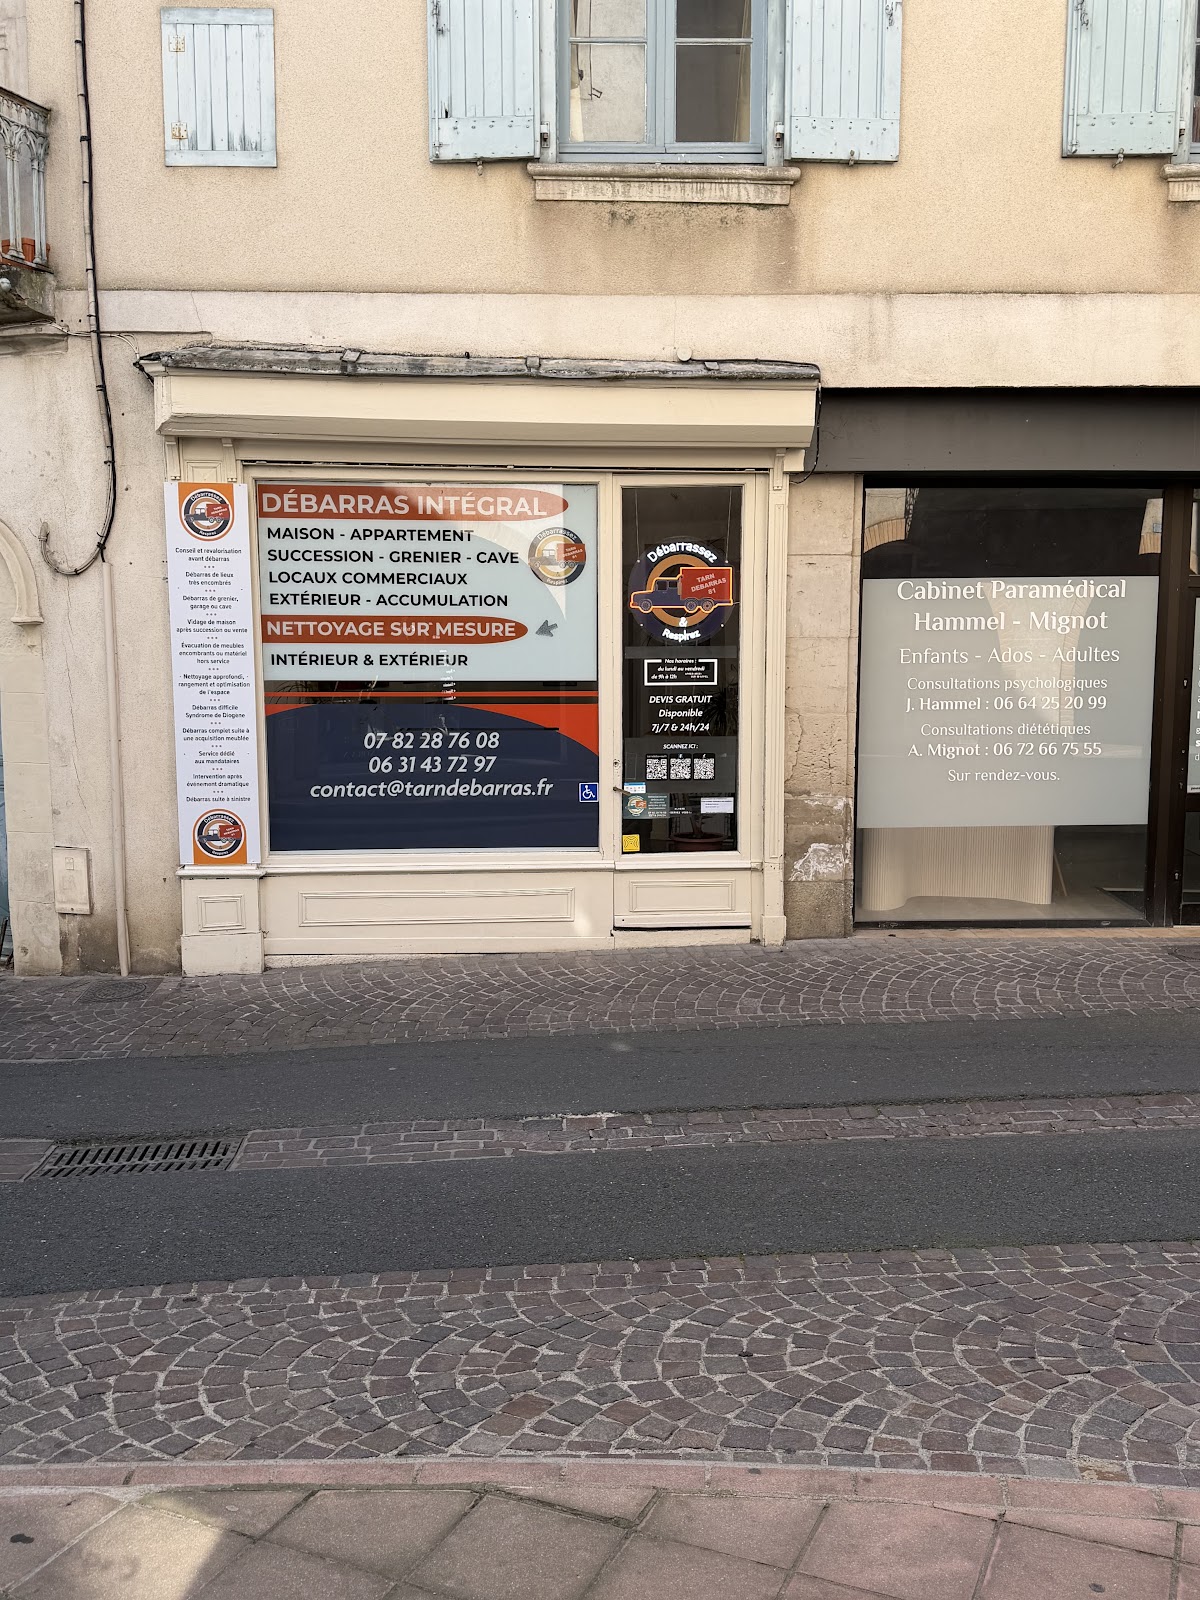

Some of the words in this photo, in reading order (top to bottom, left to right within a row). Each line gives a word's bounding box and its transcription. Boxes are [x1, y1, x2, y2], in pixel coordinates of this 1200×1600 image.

[262, 489, 410, 515] DÉBARRAS
[418, 492, 547, 516] INTÉGRAL
[267, 527, 335, 540] MAISON
[350, 528, 474, 542] APPARTEMENT
[267, 549, 373, 562] SUCCESSION
[389, 551, 461, 563] GRENIER
[476, 551, 519, 564] CAVE
[647, 542, 717, 563] Débarrassez
[268, 571, 337, 584] LOCAUX
[342, 572, 468, 585] COMMERCIAUX
[691, 578, 726, 592] DEBARRAS
[696, 573, 715, 582] TARN
[897, 581, 984, 600] Cabinet
[991, 579, 1126, 599] Paramédical
[269, 591, 361, 606] EXTÉRIEUR
[376, 594, 508, 607] ACCUMULATION
[267, 621, 384, 636] NETTOYAGE
[391, 622, 429, 637] SUR
[436, 622, 516, 637] MESURE
[679, 617, 687, 627] &
[914, 612, 1005, 631] Hammel
[1029, 611, 1108, 634] Mignot
[662, 628, 701, 642] Respirez
[271, 651, 358, 666] INTÉRIEUR
[363, 654, 374, 666] &
[379, 652, 468, 666] EXTÉRIEUR
[900, 648, 969, 664] Enfants
[988, 647, 1033, 663] Ados
[1052, 647, 1120, 662] Adultes
[907, 677, 1000, 690] Consultations
[1004, 677, 1108, 691] psychologiques
[675, 695, 712, 703] GRATUIT
[906, 698, 915, 712] J.
[920, 698, 981, 710] Hammel
[994, 697, 1013, 709] 06
[1018, 697, 1036, 709] 64
[1041, 697, 1060, 709] 25
[1064, 696, 1083, 709] 20
[1088, 696, 1107, 709] 99
[659, 709, 703, 719] Disponible
[652, 724, 669, 733] 7j/7
[680, 723, 710, 732] 24h/24
[921, 724, 1013, 735] Consultations
[1017, 723, 1091, 737] diététiques
[363, 732, 388, 750] 07
[392, 732, 414, 749] 82
[420, 732, 442, 749] 28
[448, 732, 470, 749] 76
[475, 732, 500, 749] 08
[908, 745, 922, 756] A.
[927, 743, 981, 760] Mignot
[993, 743, 1013, 756] 06
[1017, 743, 1034, 756] 72
[1038, 743, 1058, 756] 66
[1062, 742, 1079, 755] 75
[1083, 742, 1102, 755] 55
[368, 756, 393, 773] 06
[398, 757, 416, 773] 31
[420, 756, 442, 773] 43
[447, 756, 468, 773] 72
[473, 756, 497, 773] 97
[948, 769, 970, 782] Sur
[975, 769, 1060, 781] rendez-vous.
[310, 778, 554, 798] contact@tarndebarras.fr
